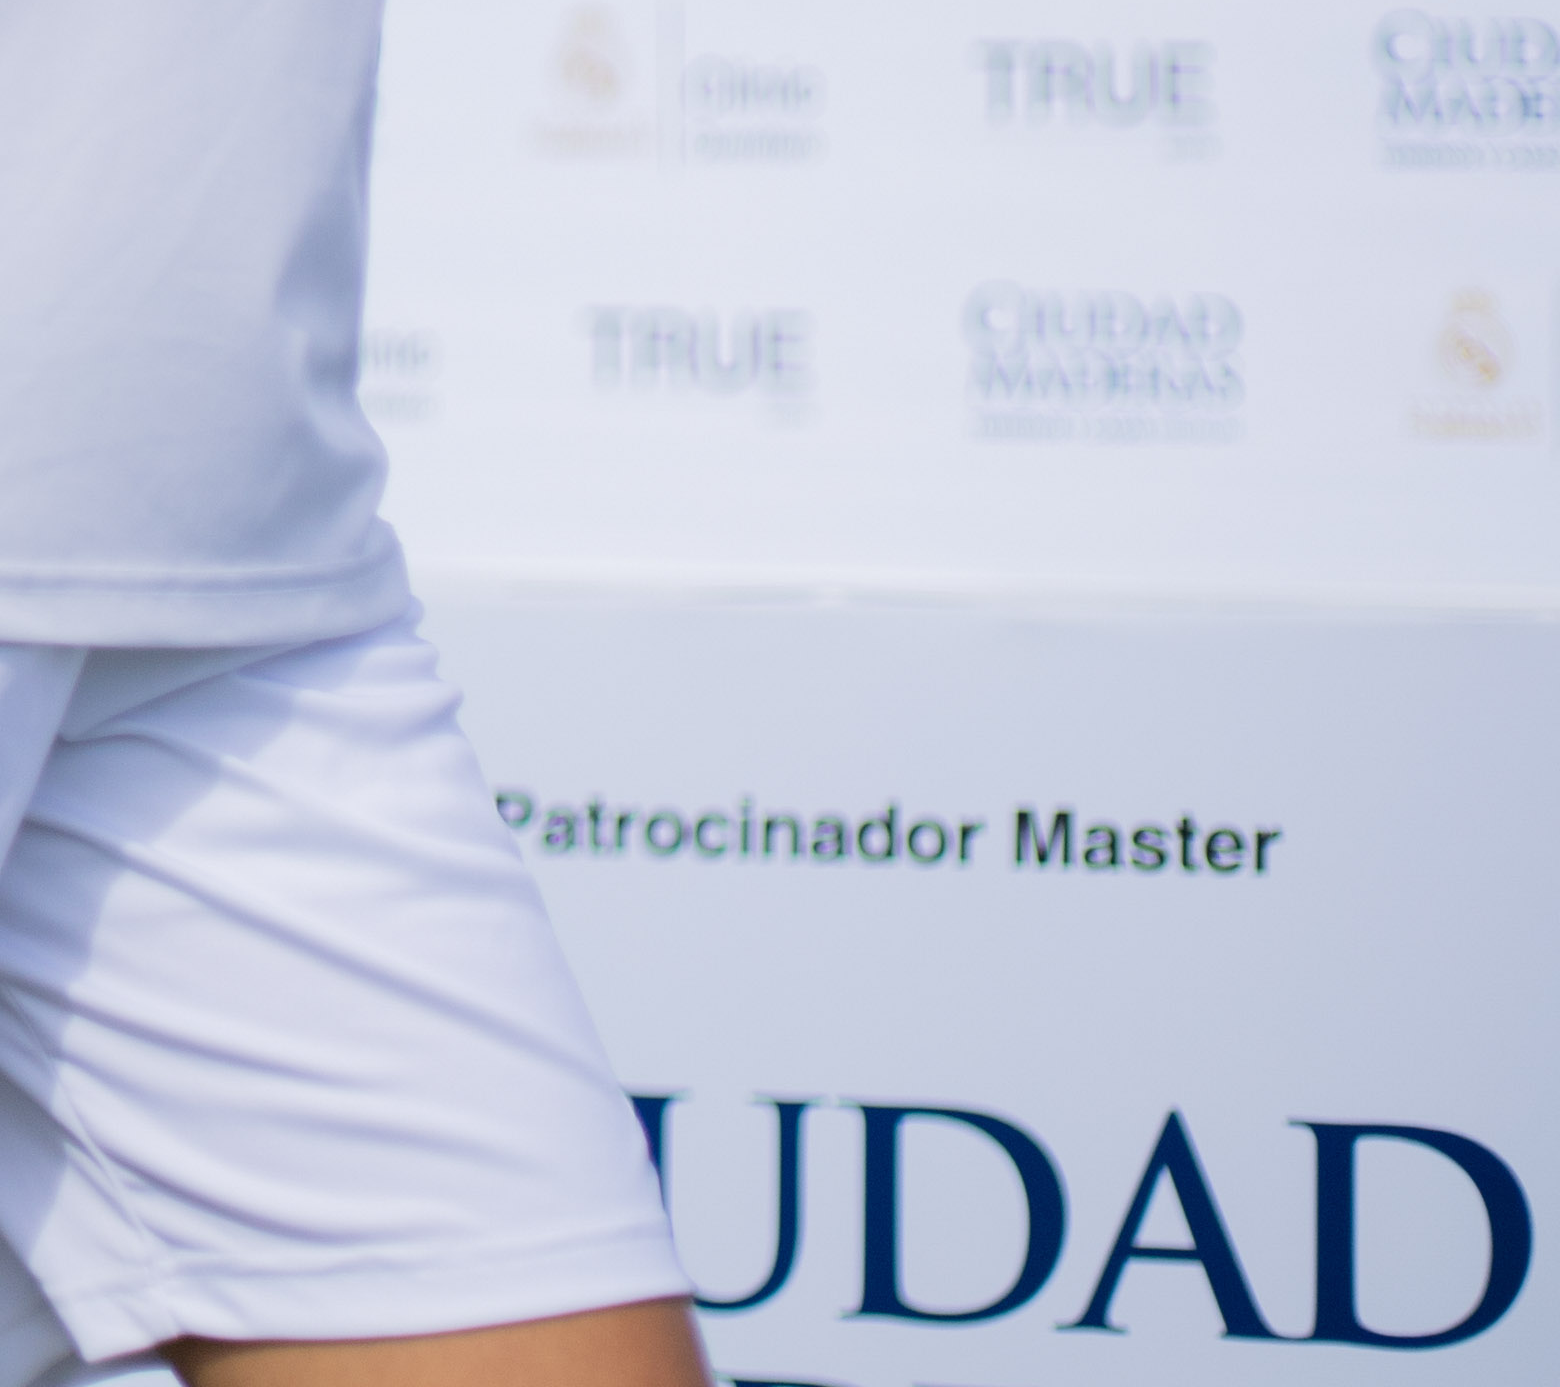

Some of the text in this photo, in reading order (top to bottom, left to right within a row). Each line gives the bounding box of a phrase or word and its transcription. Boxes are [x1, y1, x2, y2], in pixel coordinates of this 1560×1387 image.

[974, 37, 1214, 131] TRUE
[492, 789, 1284, 877] Patrocinador Master
